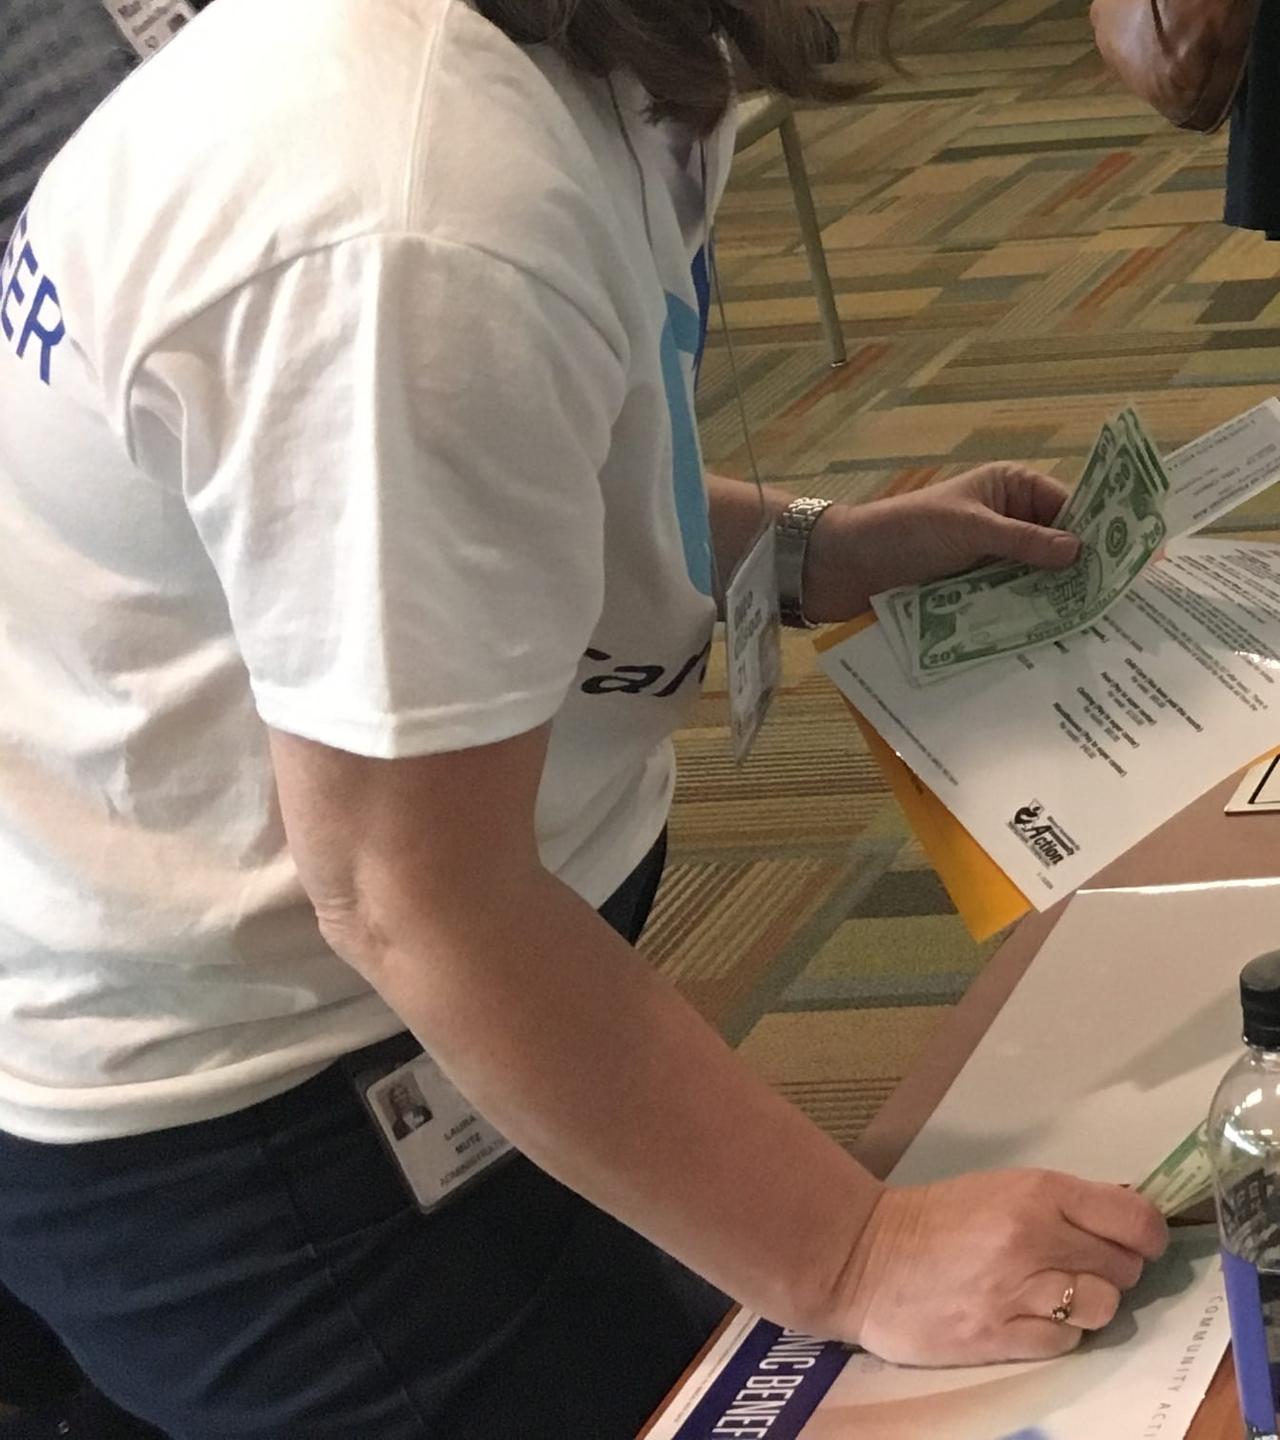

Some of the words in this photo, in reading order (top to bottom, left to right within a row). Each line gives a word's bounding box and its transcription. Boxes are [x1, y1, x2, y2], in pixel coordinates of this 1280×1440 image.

[929, 589, 962, 613] 20
[926, 650, 952, 666] 20
[1022, 826, 1065, 866] Action
[1167, 1294, 1223, 1391] COMMUNITY
